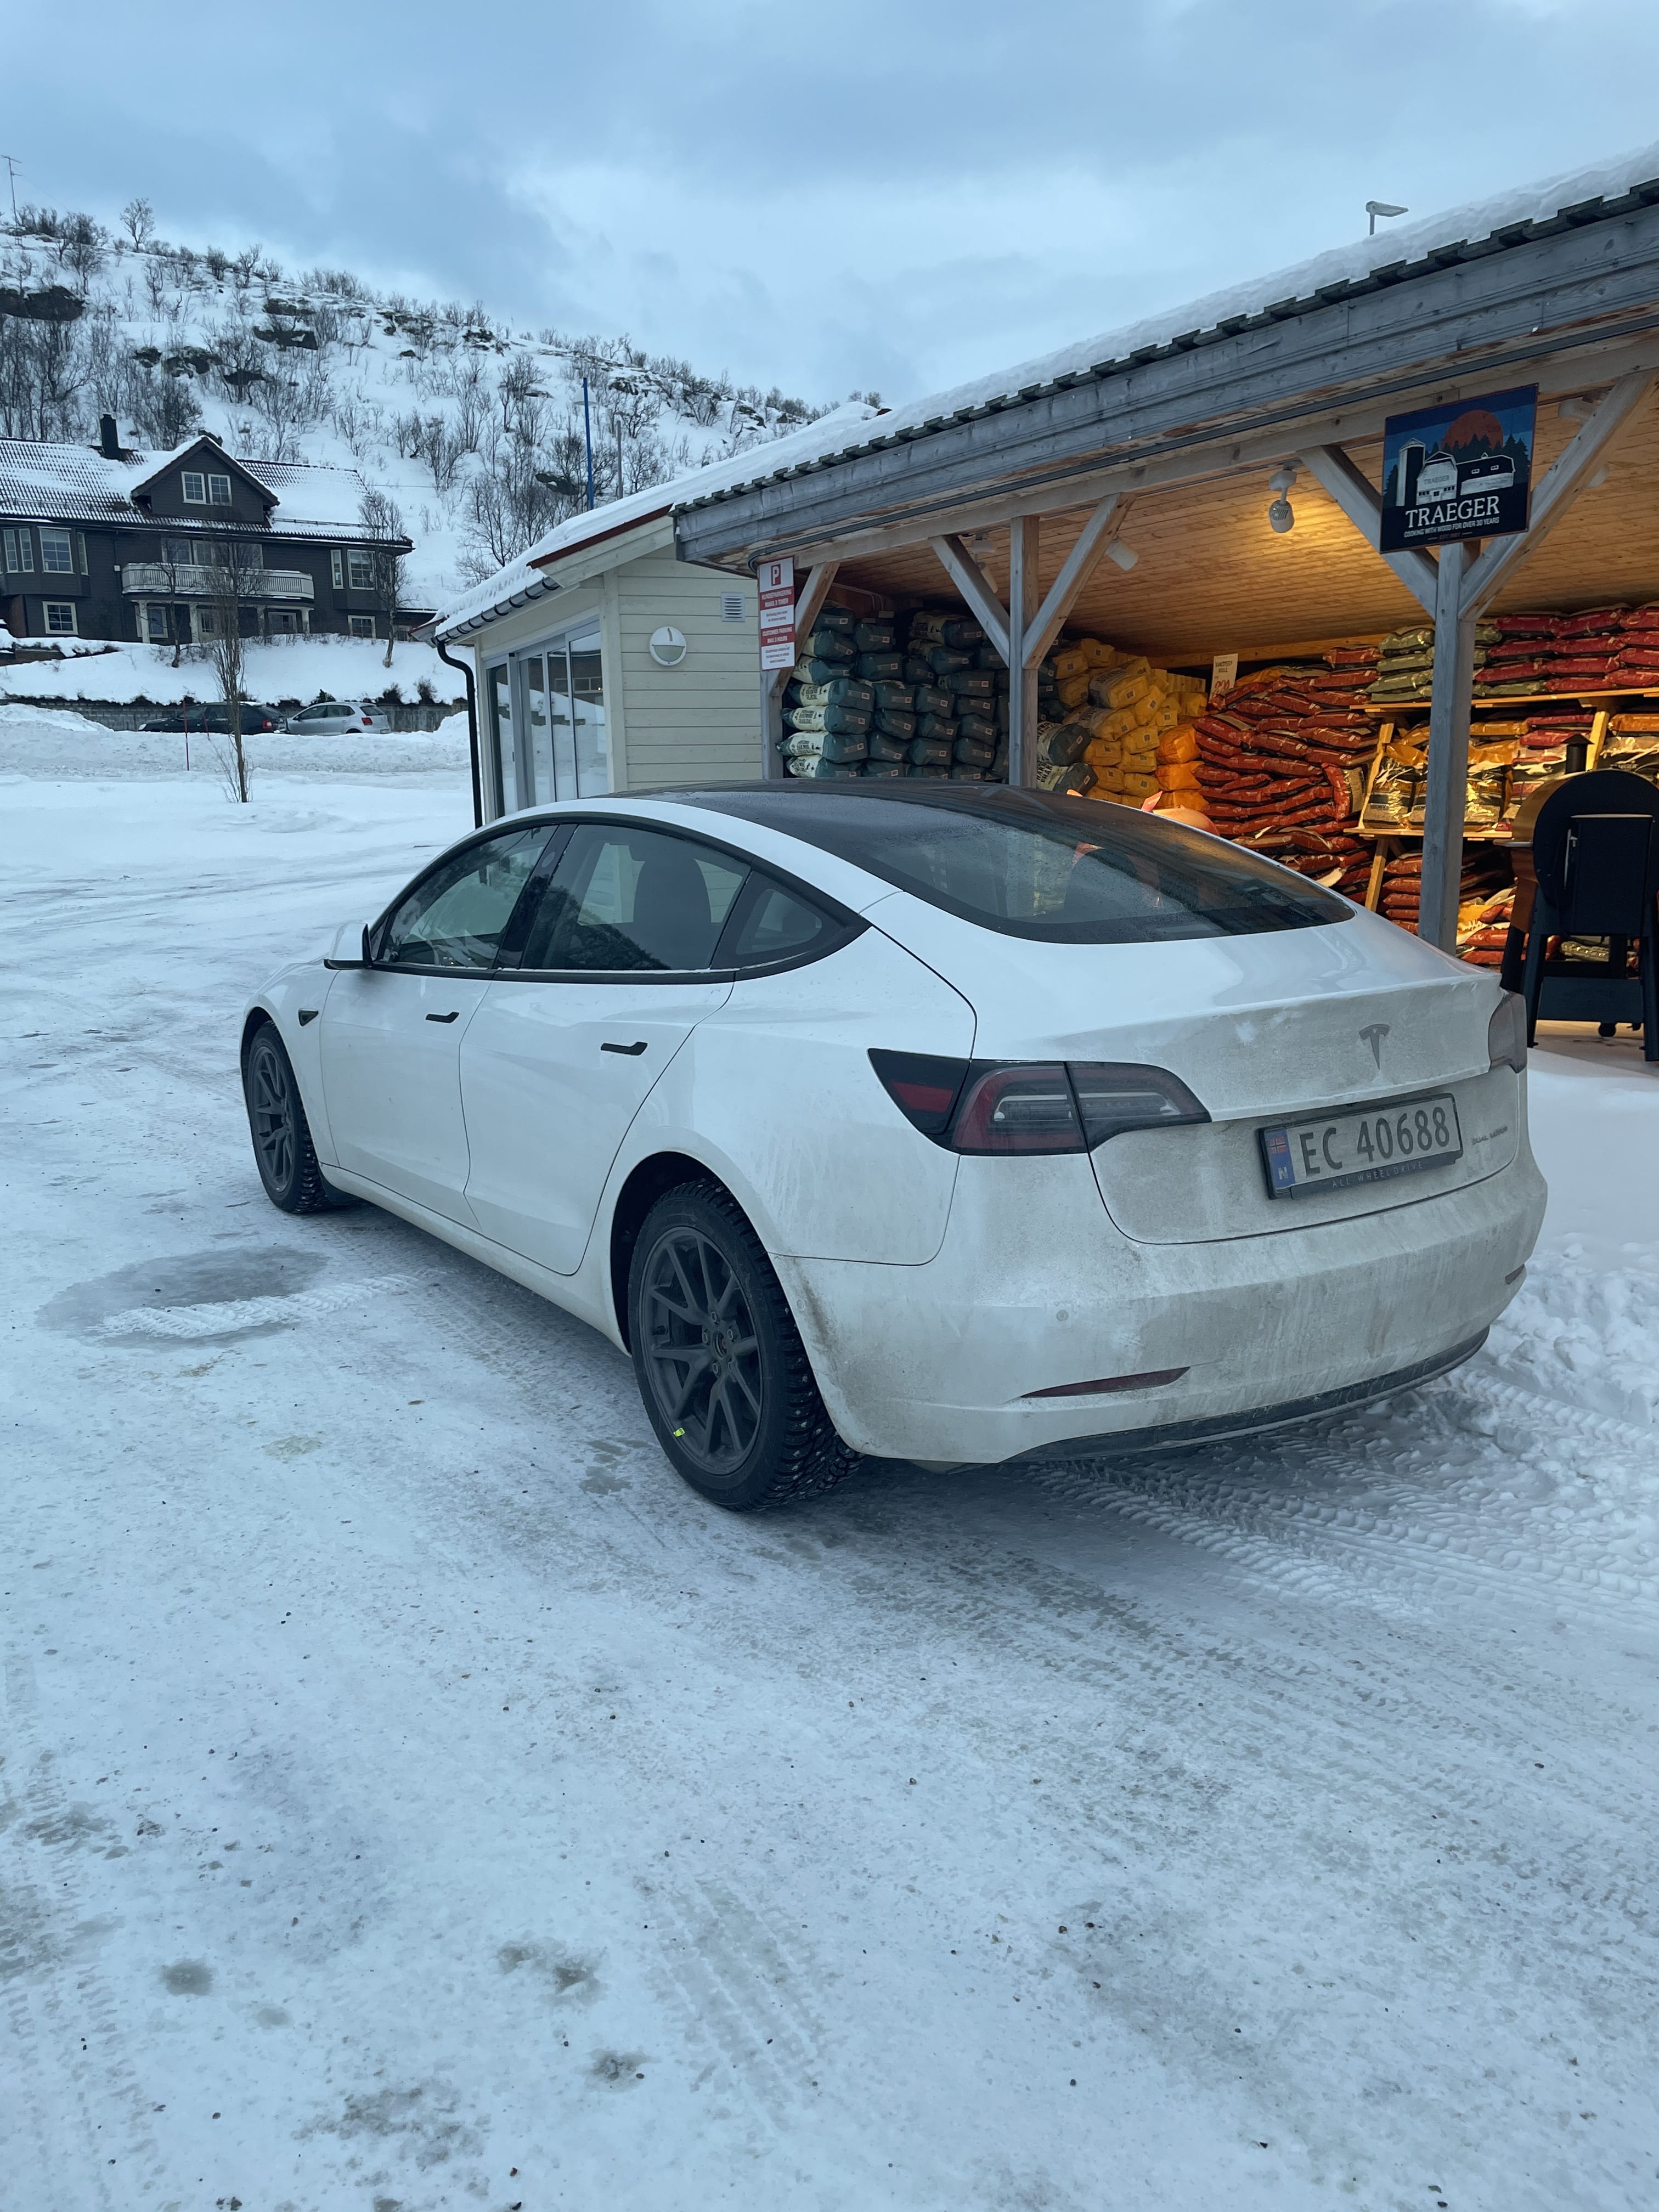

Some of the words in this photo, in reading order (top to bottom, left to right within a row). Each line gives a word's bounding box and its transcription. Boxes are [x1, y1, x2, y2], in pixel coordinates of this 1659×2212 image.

[1424, 475, 1449, 486] TRAEGER
[1405, 495, 1500, 528] TRAEGER
[1404, 529, 1424, 538] COOKING
[1425, 526, 1437, 534] WITH
[1463, 520, 1476, 528] OVER
[1483, 517, 1500, 525] YEARS
[772, 566, 780, 585] P
[1299, 1127, 1342, 1178] EC
[1357, 1106, 1450, 1163] 40688
[1277, 1166, 1289, 1180] N
